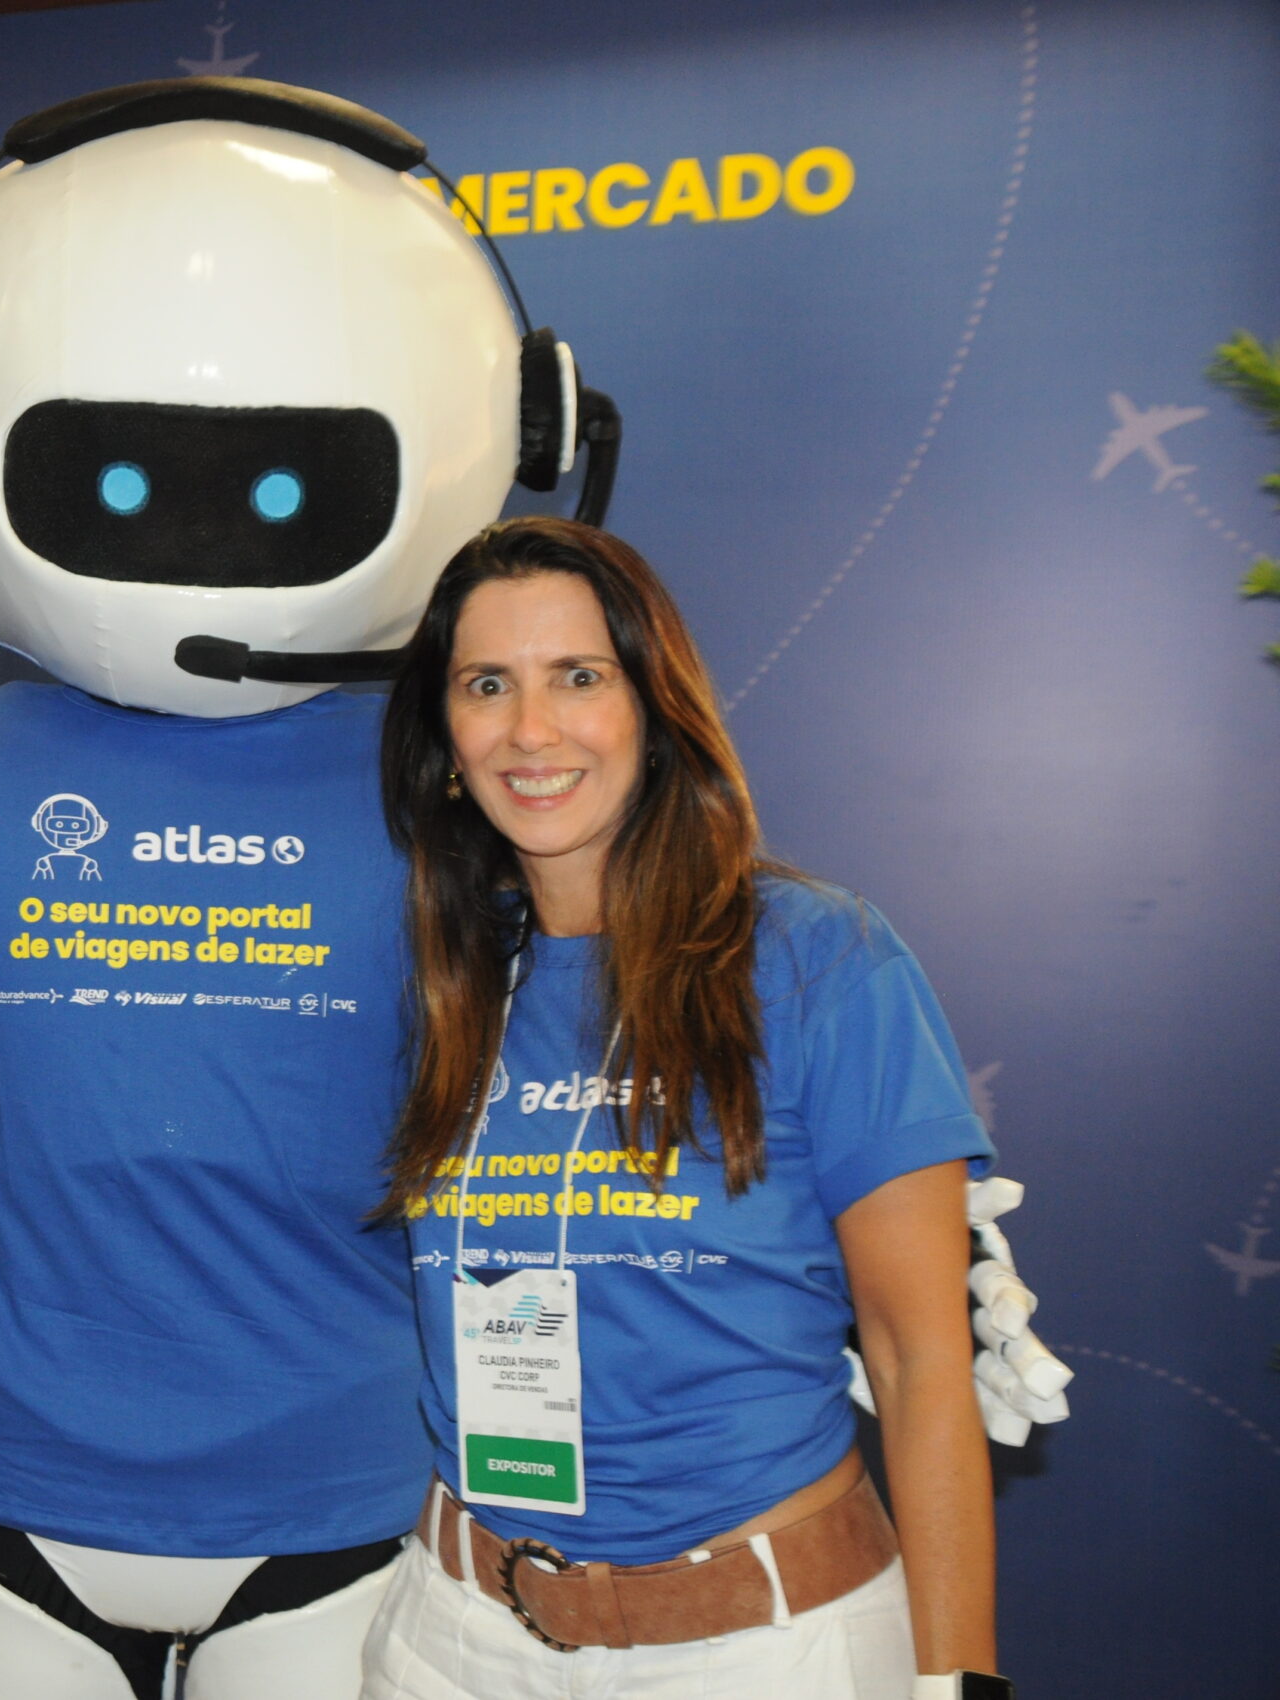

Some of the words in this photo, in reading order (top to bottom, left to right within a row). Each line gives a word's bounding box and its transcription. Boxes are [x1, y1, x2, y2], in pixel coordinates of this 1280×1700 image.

[133, 825, 266, 865] atlas
[19, 897, 44, 922] O
[49, 900, 110, 923] seu
[116, 902, 202, 927] novo
[207, 903, 312, 935] portal
[9, 933, 50, 959] de
[55, 931, 190, 969] viagens
[195, 936, 239, 963] de
[245, 937, 331, 966] lazer
[74, 988, 110, 999] TREND
[134, 992, 188, 1005] Visual
[205, 994, 291, 1007] ESFERATUR
[521, 1071, 634, 1115] atlas
[488, 1154, 561, 1178] novo
[432, 1186, 550, 1226] viagens
[554, 1185, 594, 1217] de
[599, 1184, 700, 1221] lazer
[483, 1320, 527, 1335] ABAV
[478, 1355, 517, 1368] CLAUDIA
[519, 1356, 560, 1370] PINHEIRO
[500, 1371, 517, 1381] CVC
[518, 1372, 540, 1382] CORP
[487, 1458, 556, 1477] EXPOSITOR
